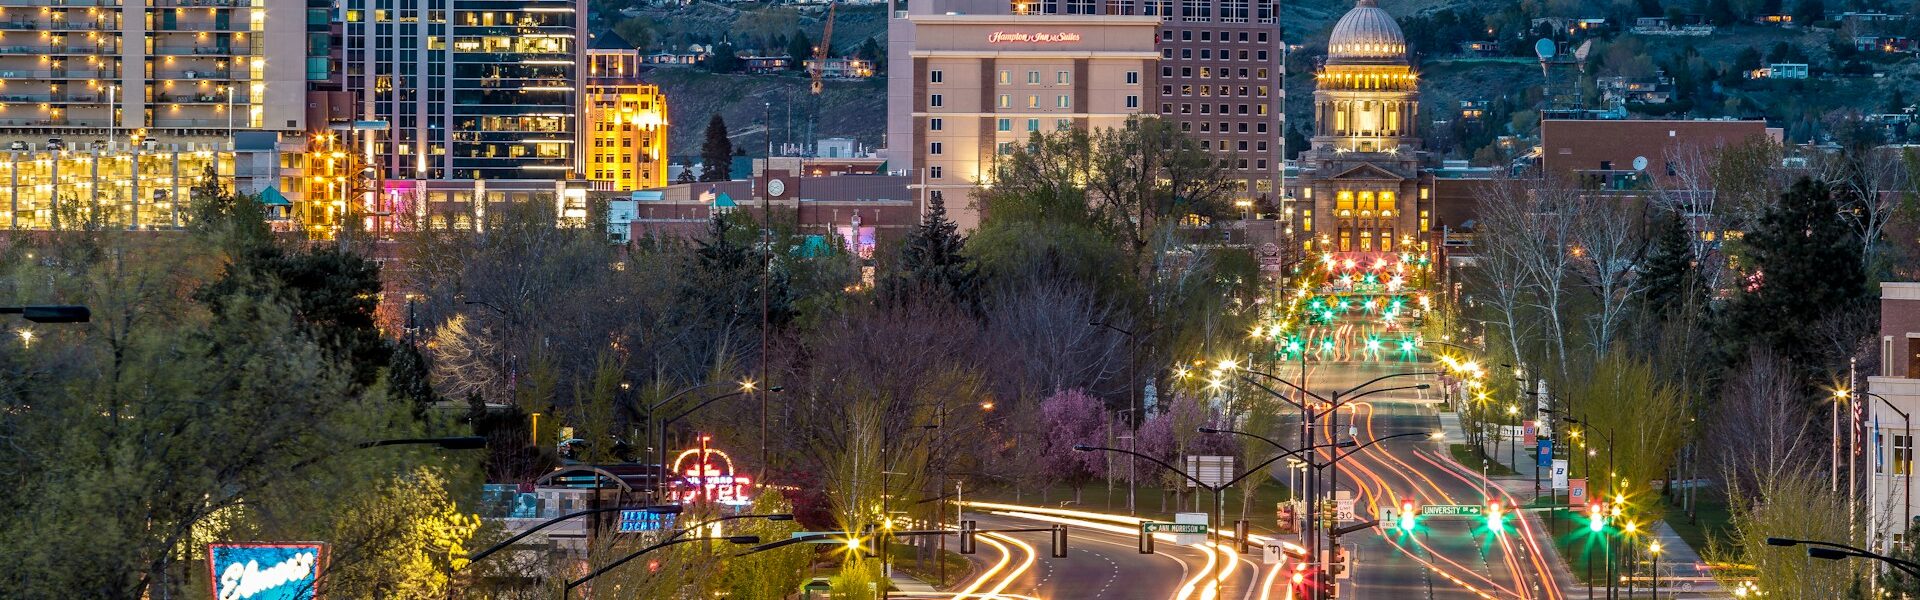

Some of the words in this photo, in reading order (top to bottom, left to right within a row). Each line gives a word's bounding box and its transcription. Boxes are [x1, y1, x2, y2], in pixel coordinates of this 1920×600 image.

[989, 31, 1031, 43] Hampton
[1031, 32, 1052, 42] Inn
[1057, 32, 1080, 42] Suites
[1556, 467, 1564, 475] B
[1424, 506, 1460, 514] UNIVERSITY
[1171, 525, 1198, 533] MORRISON
